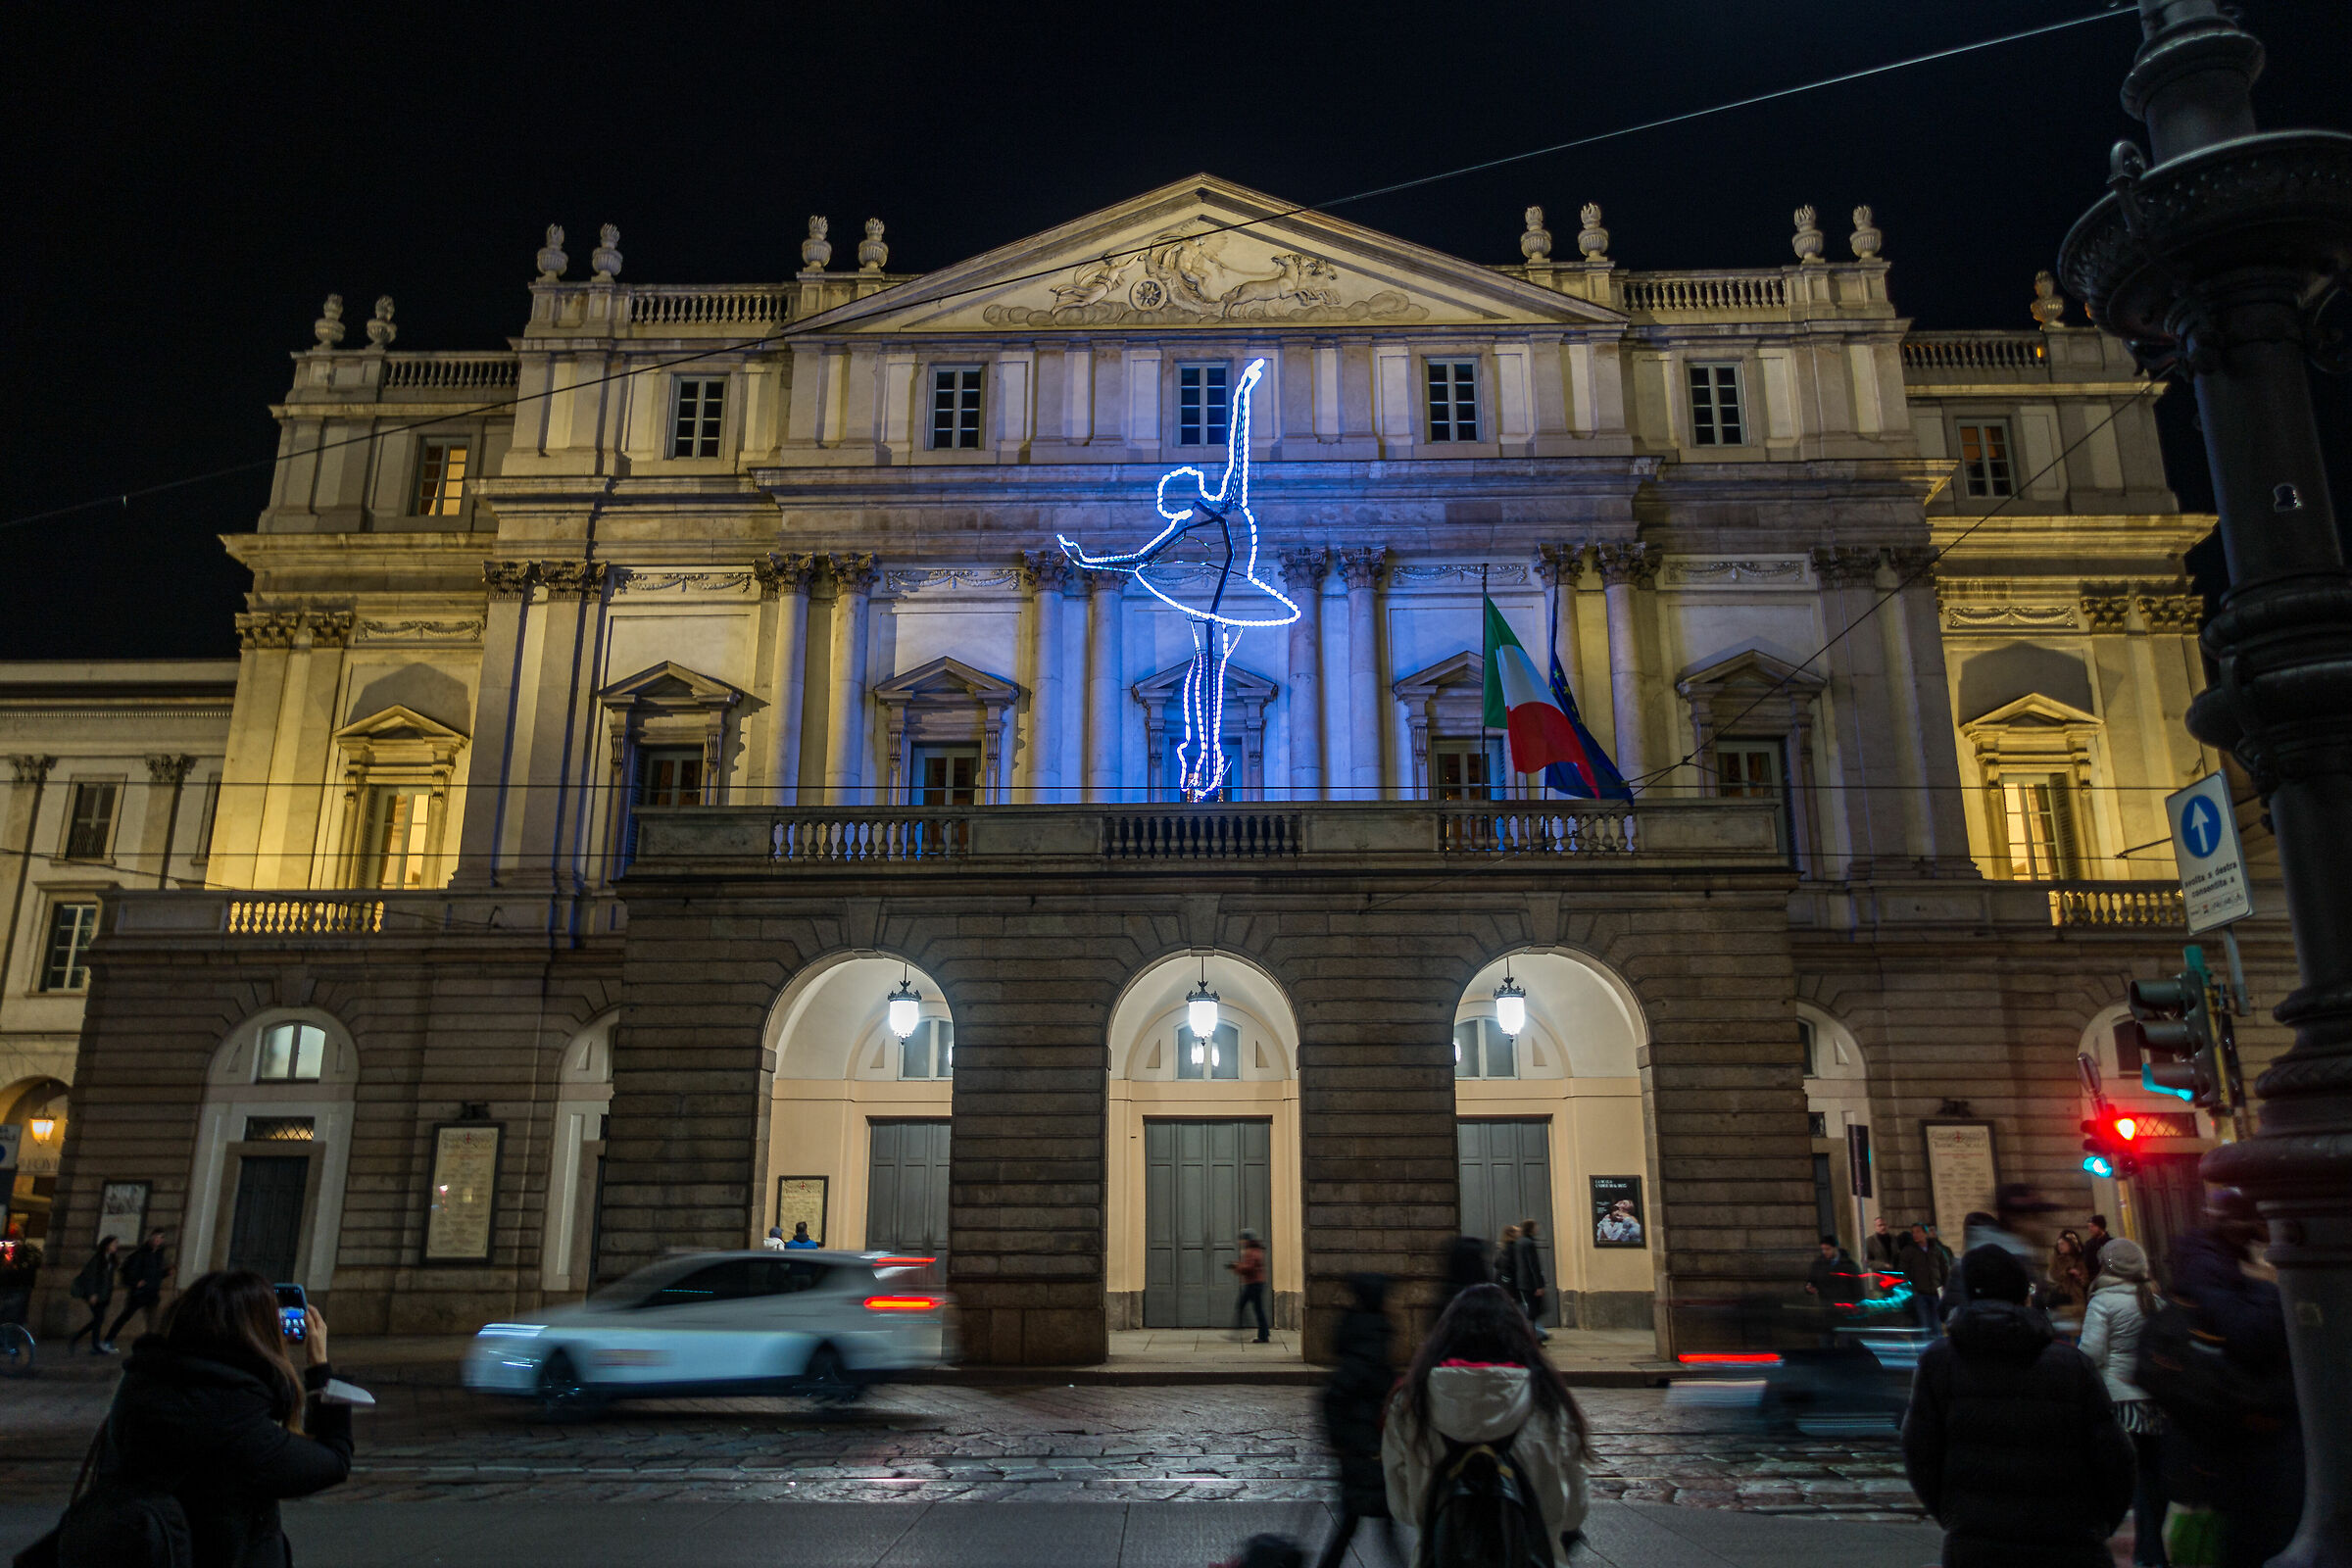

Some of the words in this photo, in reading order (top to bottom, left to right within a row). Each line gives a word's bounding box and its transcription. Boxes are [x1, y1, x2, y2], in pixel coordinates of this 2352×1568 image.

[2184, 875, 2205, 888] svolta
[2215, 862, 2237, 876] destra
[2191, 879, 2228, 898] consentita
